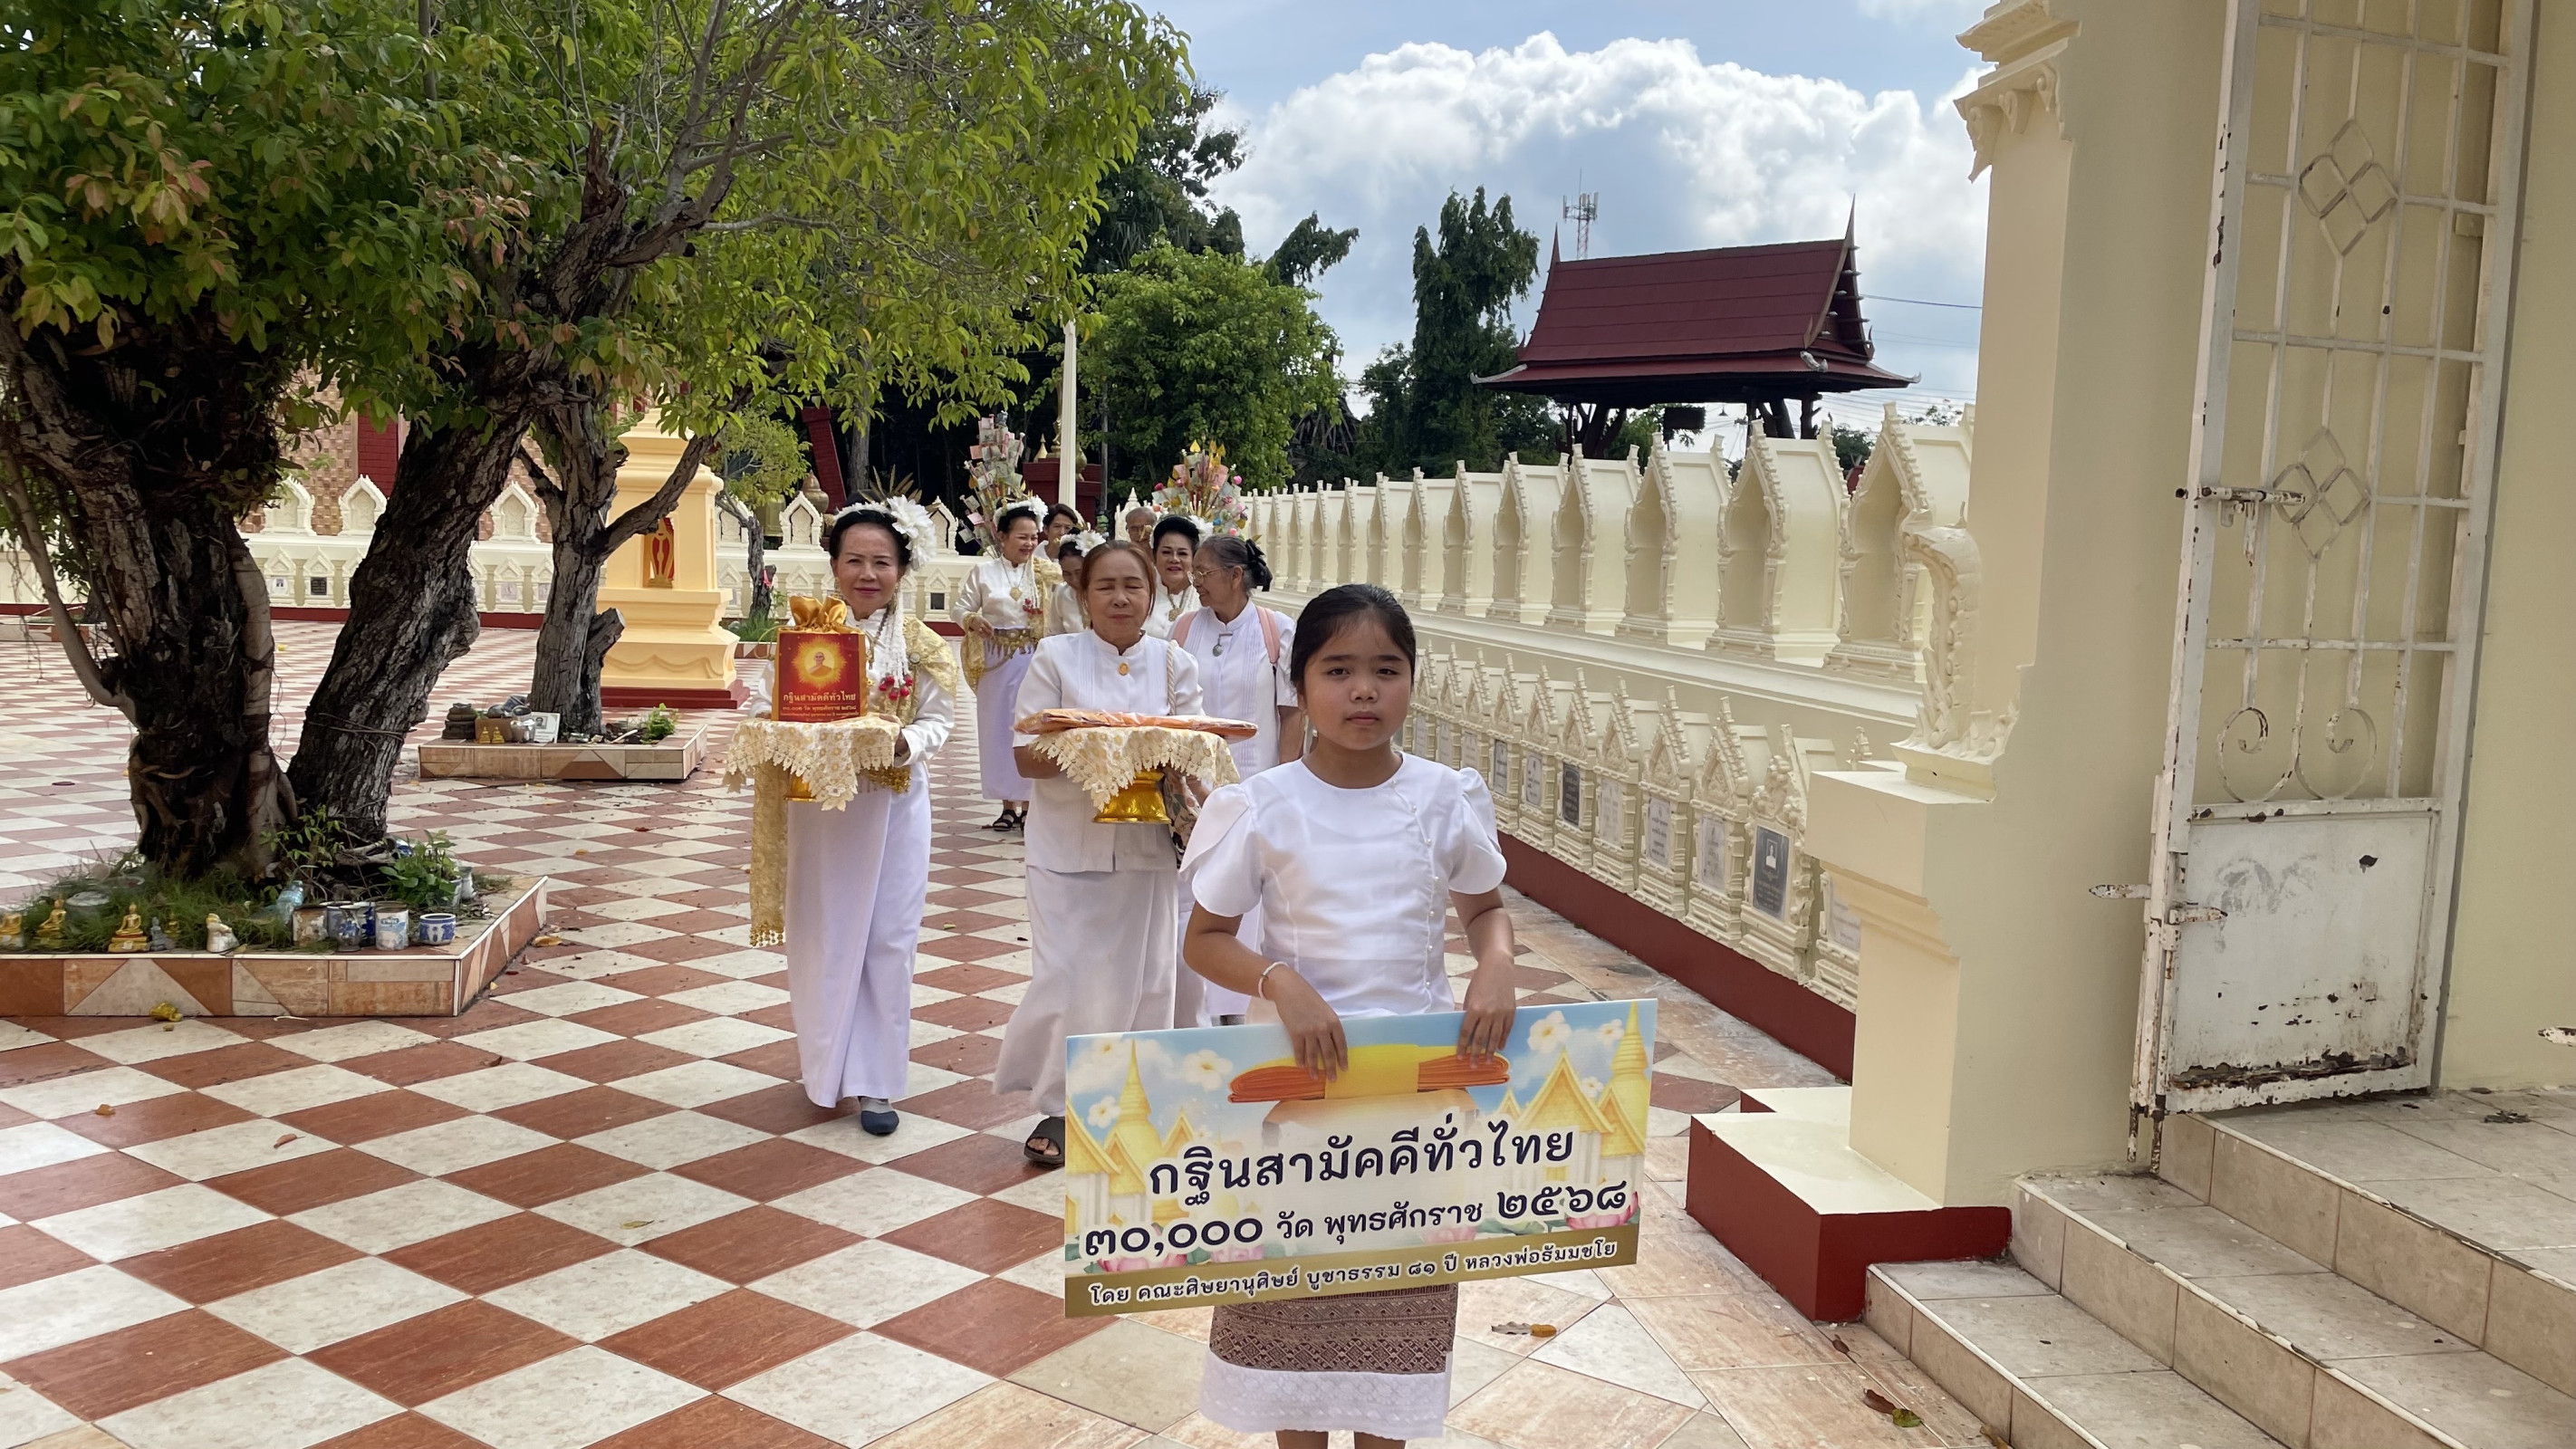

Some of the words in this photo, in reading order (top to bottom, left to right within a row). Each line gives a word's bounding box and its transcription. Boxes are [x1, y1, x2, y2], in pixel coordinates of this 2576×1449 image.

[1149, 1112, 1574, 1206] กฐินสามัคคีทั่วไทย
[1085, 1217, 1264, 1257] ๓๐,๐๐๐
[1276, 1210, 1314, 1240] วัด
[1323, 1200, 1484, 1245] พุทธศักราช
[1496, 1179, 1628, 1220] ๒๕๖๘
[1090, 1284, 1129, 1304] โดย
[1138, 1266, 1299, 1300] คณะศิษยานุศิษย์
[1307, 1263, 1400, 1291] บูชาธรรม
[1408, 1261, 1436, 1275] ๘๑
[1443, 1253, 1457, 1271] ปี
[1465, 1239, 1617, 1270] หลวงพ่อธัมมชโย
